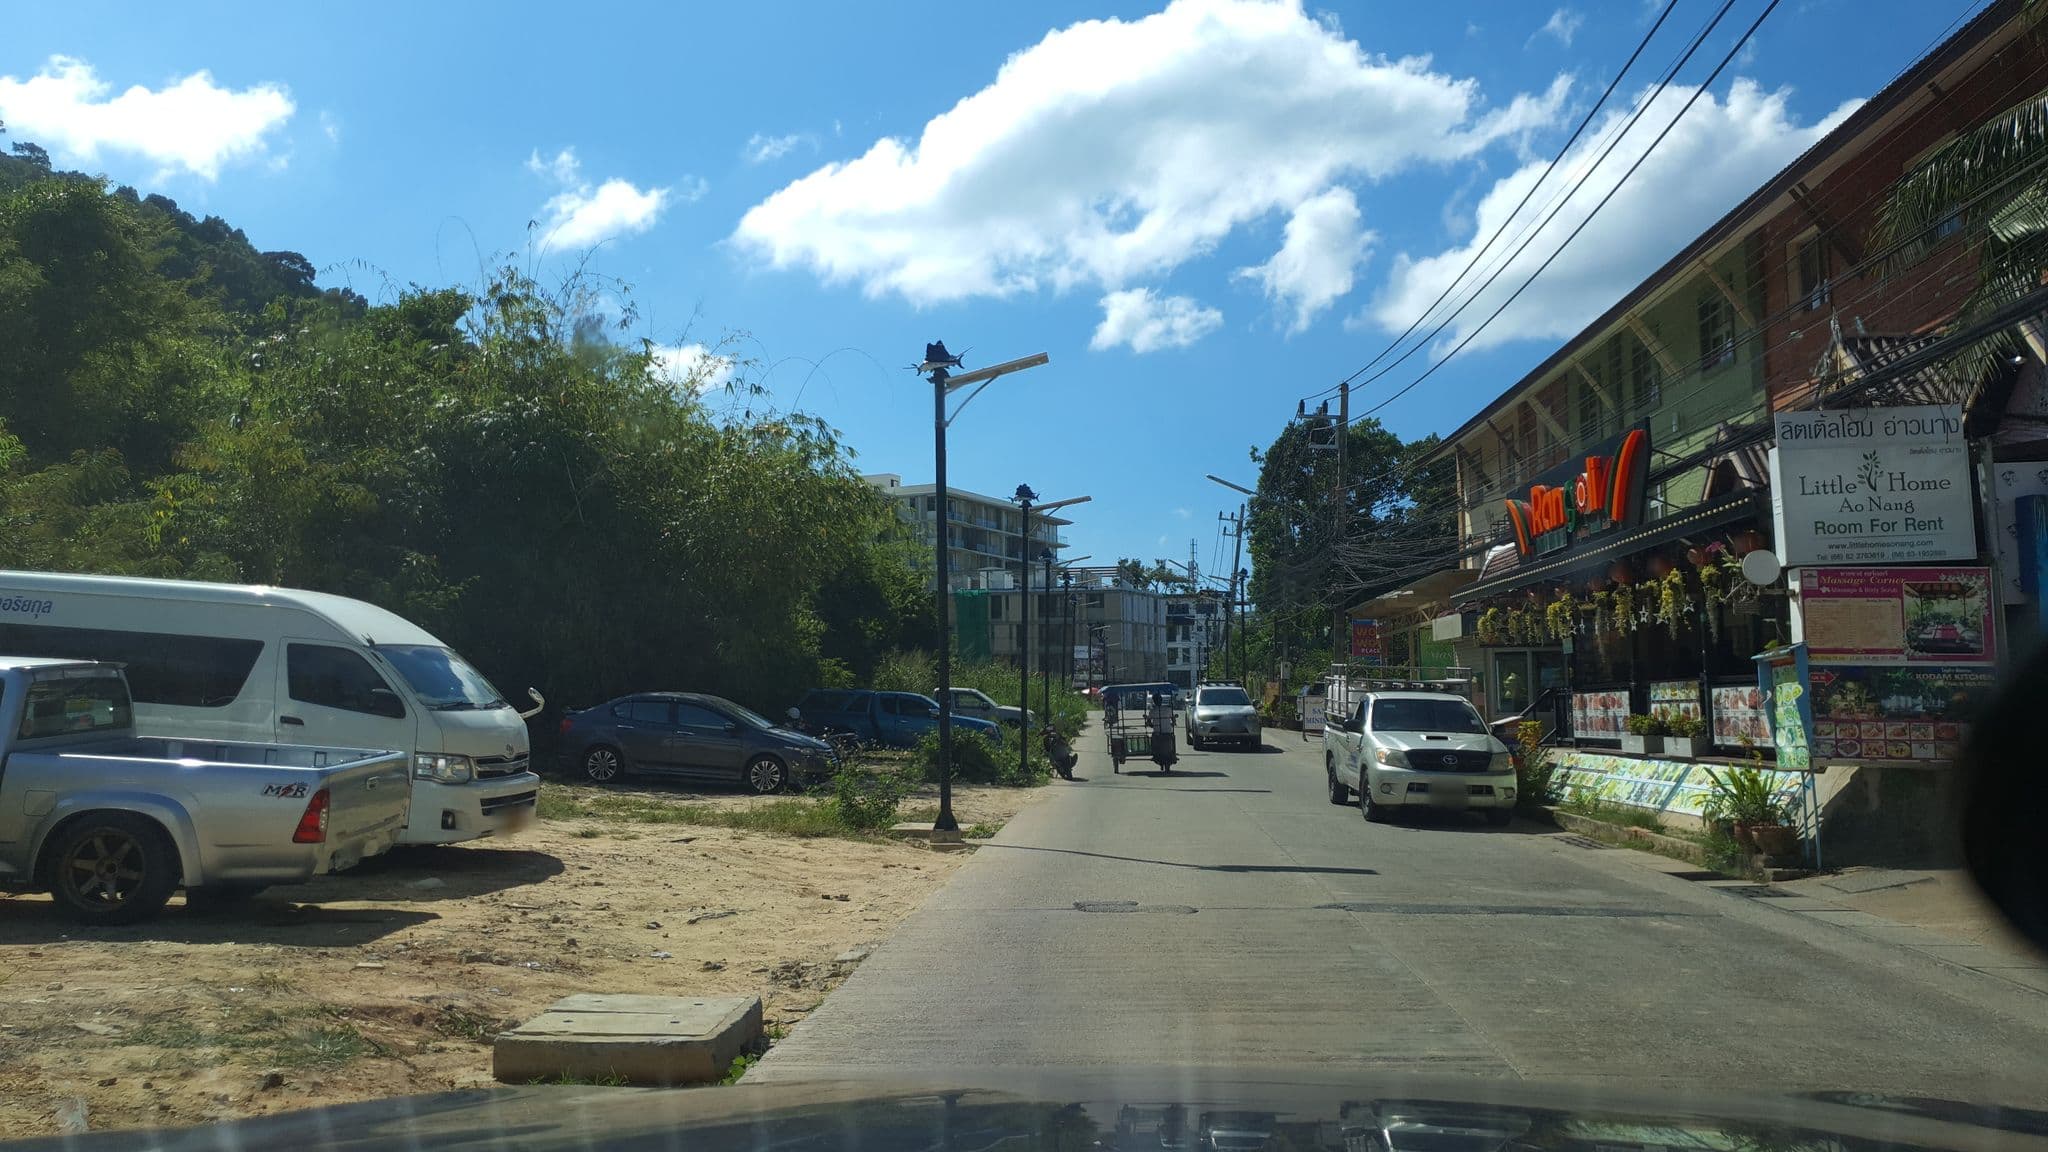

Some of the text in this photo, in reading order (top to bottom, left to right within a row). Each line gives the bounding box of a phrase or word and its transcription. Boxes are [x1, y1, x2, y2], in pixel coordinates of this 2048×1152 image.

[1780, 414, 1959, 441] ลิตเติ้ลโฮม อ่าวนาง
[1798, 471, 1951, 496] Little Home
[1838, 496, 1915, 514] Ao Nang
[1814, 516, 1944, 536] Room For Rent
